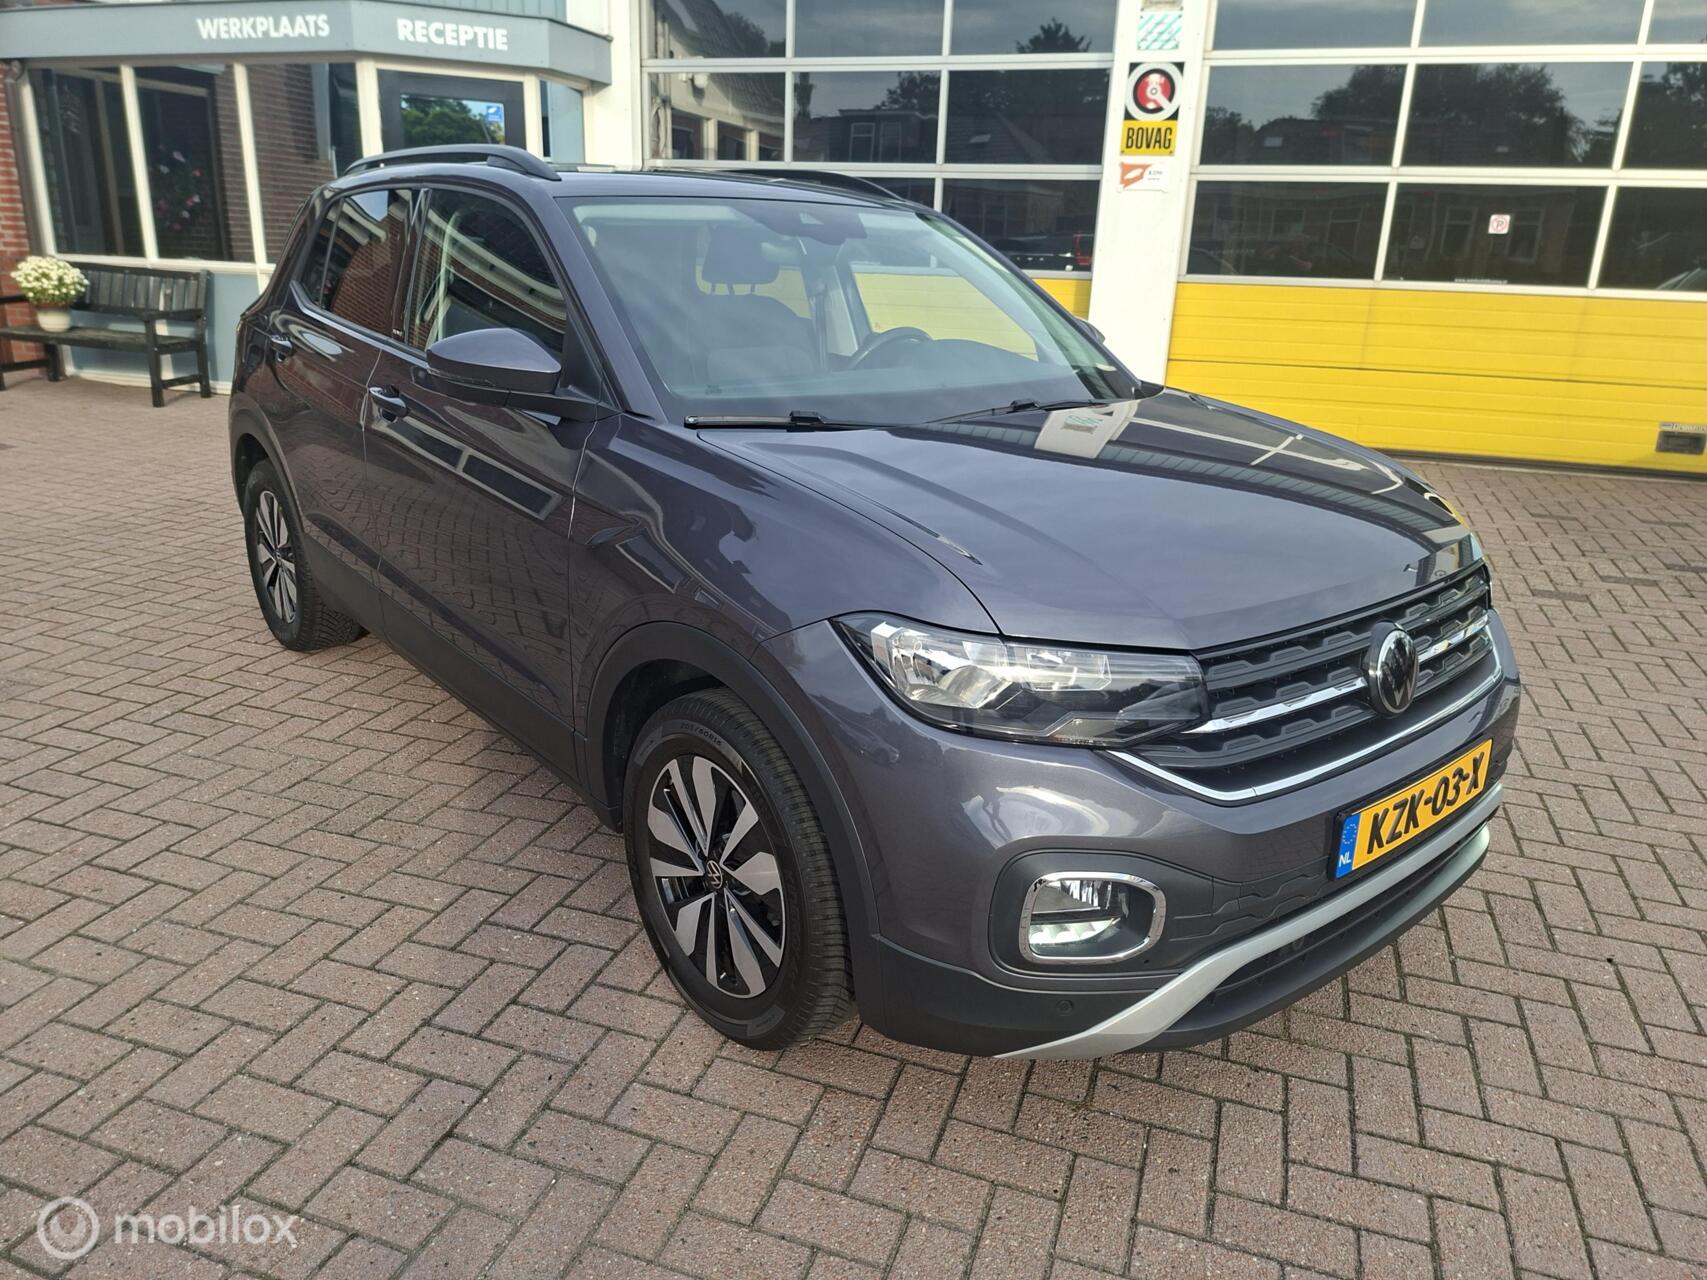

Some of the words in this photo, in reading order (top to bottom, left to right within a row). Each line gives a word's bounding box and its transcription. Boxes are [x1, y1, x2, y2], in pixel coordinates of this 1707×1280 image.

[196, 14, 330, 40] WERKPLAATS
[397, 18, 508, 50] RECEPTIE
[1126, 127, 1173, 149] BOVAG
[1367, 752, 1485, 854] KZK-03-X
[1339, 854, 1352, 868] NL
